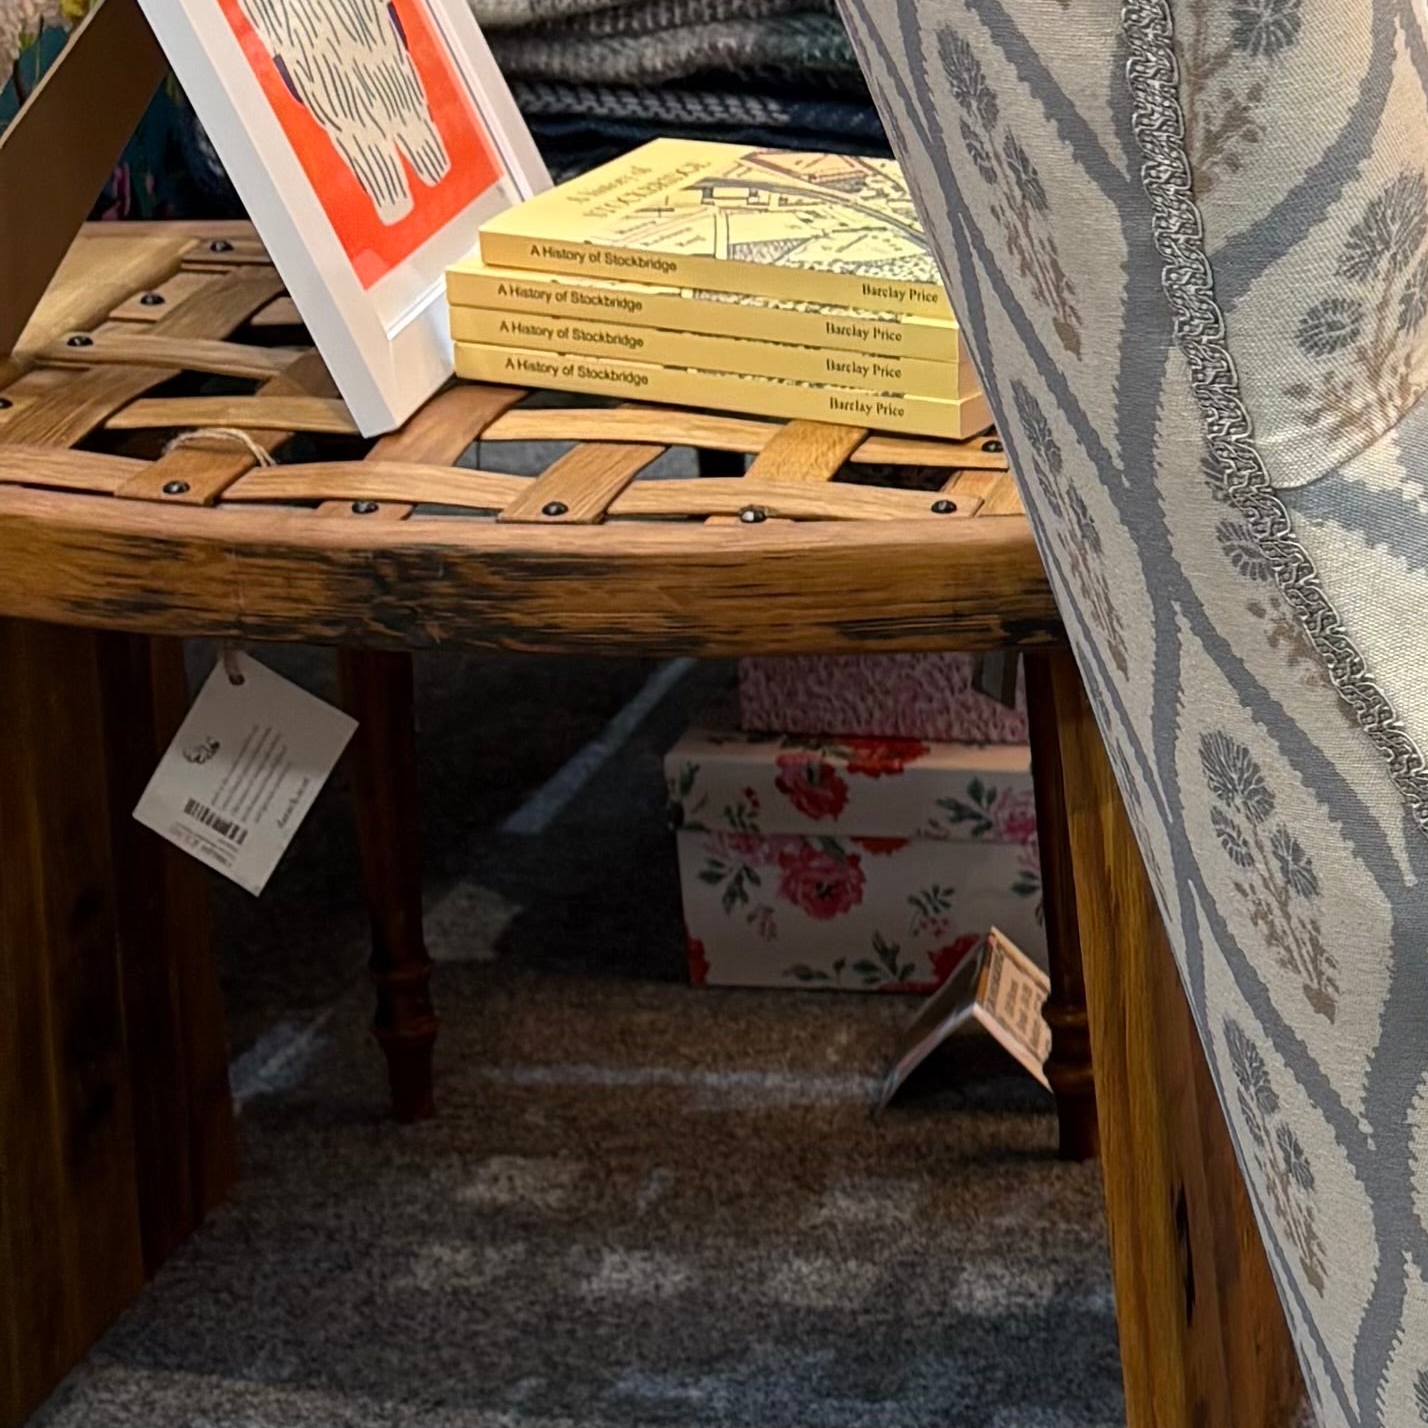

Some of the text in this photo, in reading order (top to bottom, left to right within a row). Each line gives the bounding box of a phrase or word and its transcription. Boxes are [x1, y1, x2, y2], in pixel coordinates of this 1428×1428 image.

[530, 244, 677, 274] A History of Stockbridge
[498, 283, 643, 313] A History of Stockbridge
[862, 283, 938, 303] Barclay Price
[500, 320, 644, 349] A History of Stockbridge
[826, 322, 902, 342] Barclay Price
[505, 357, 649, 386] A History of Stockbridge
[826, 358, 902, 379] Barclay Price
[829, 397, 904, 417] Barclay Price
